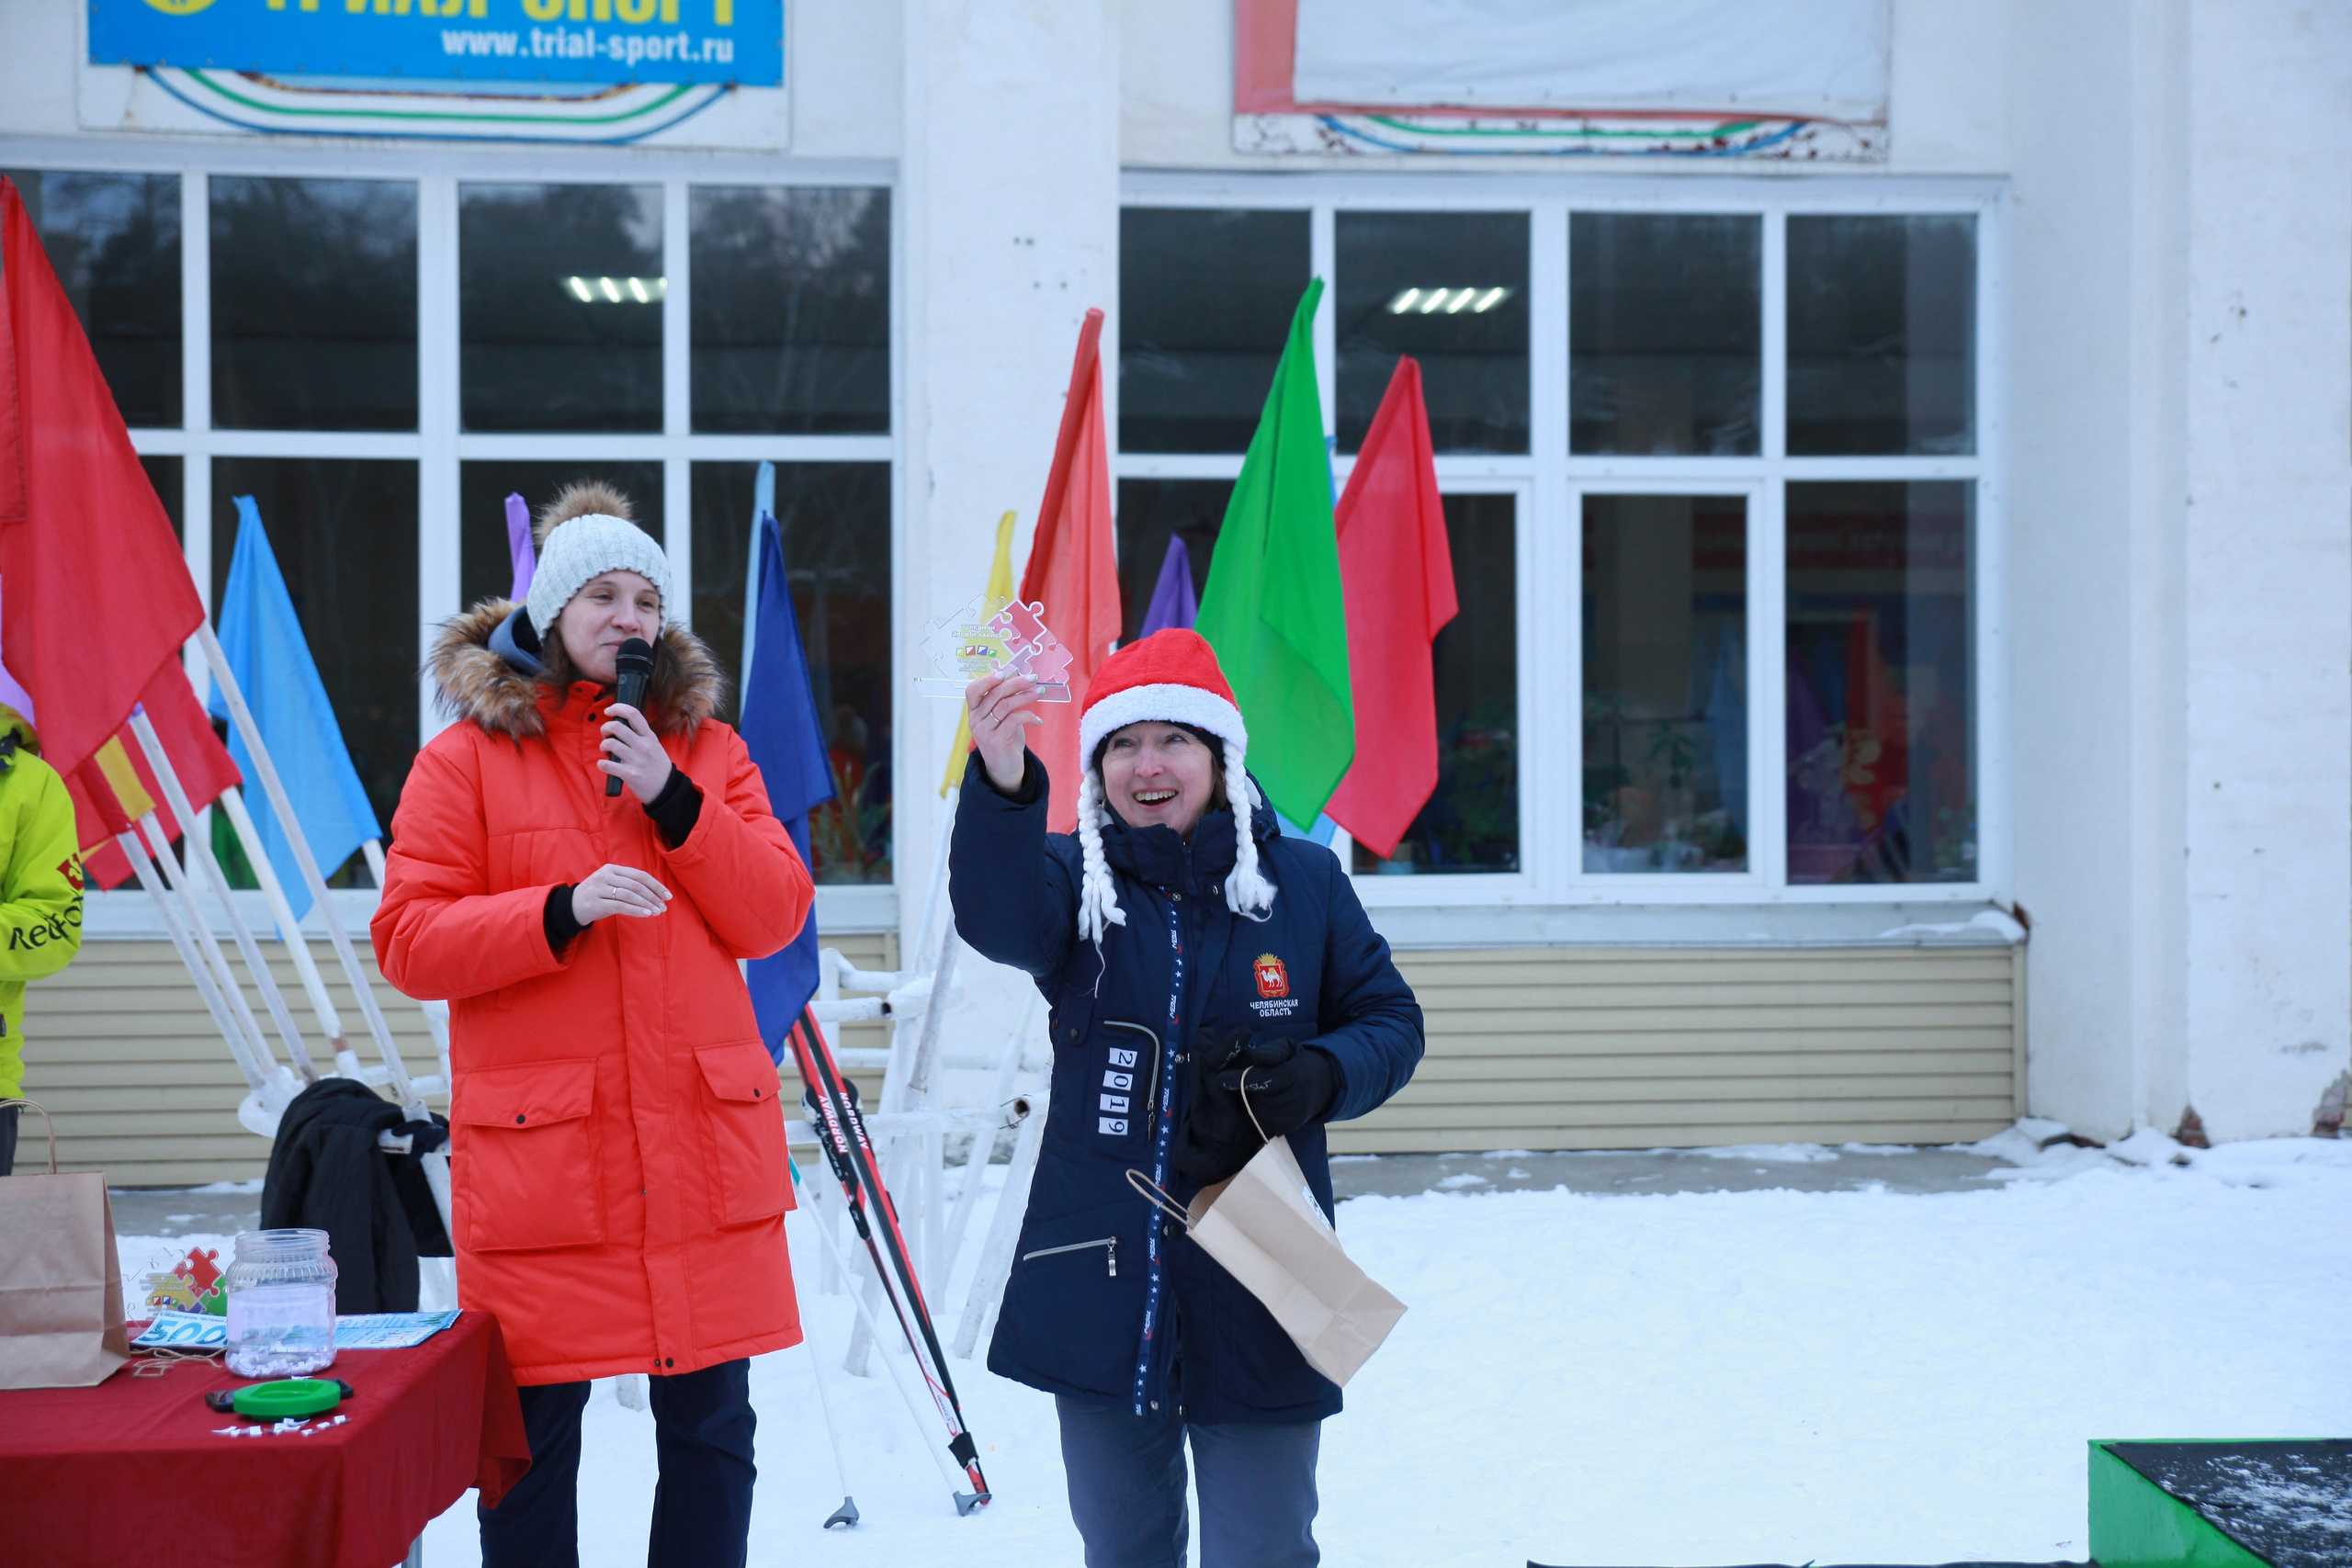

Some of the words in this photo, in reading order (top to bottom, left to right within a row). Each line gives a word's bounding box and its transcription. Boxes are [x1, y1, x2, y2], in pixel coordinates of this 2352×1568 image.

[442, 29, 733, 65] www.trial-sport.ru
[1250, 998, 1298, 1010] ЧЕЛЯБИНСКАЯ
[1259, 1008, 1292, 1017] ОБЛАСТЬ
[818, 1094, 848, 1154] NORDWAY
[839, 1091, 869, 1150] NORDWAY
